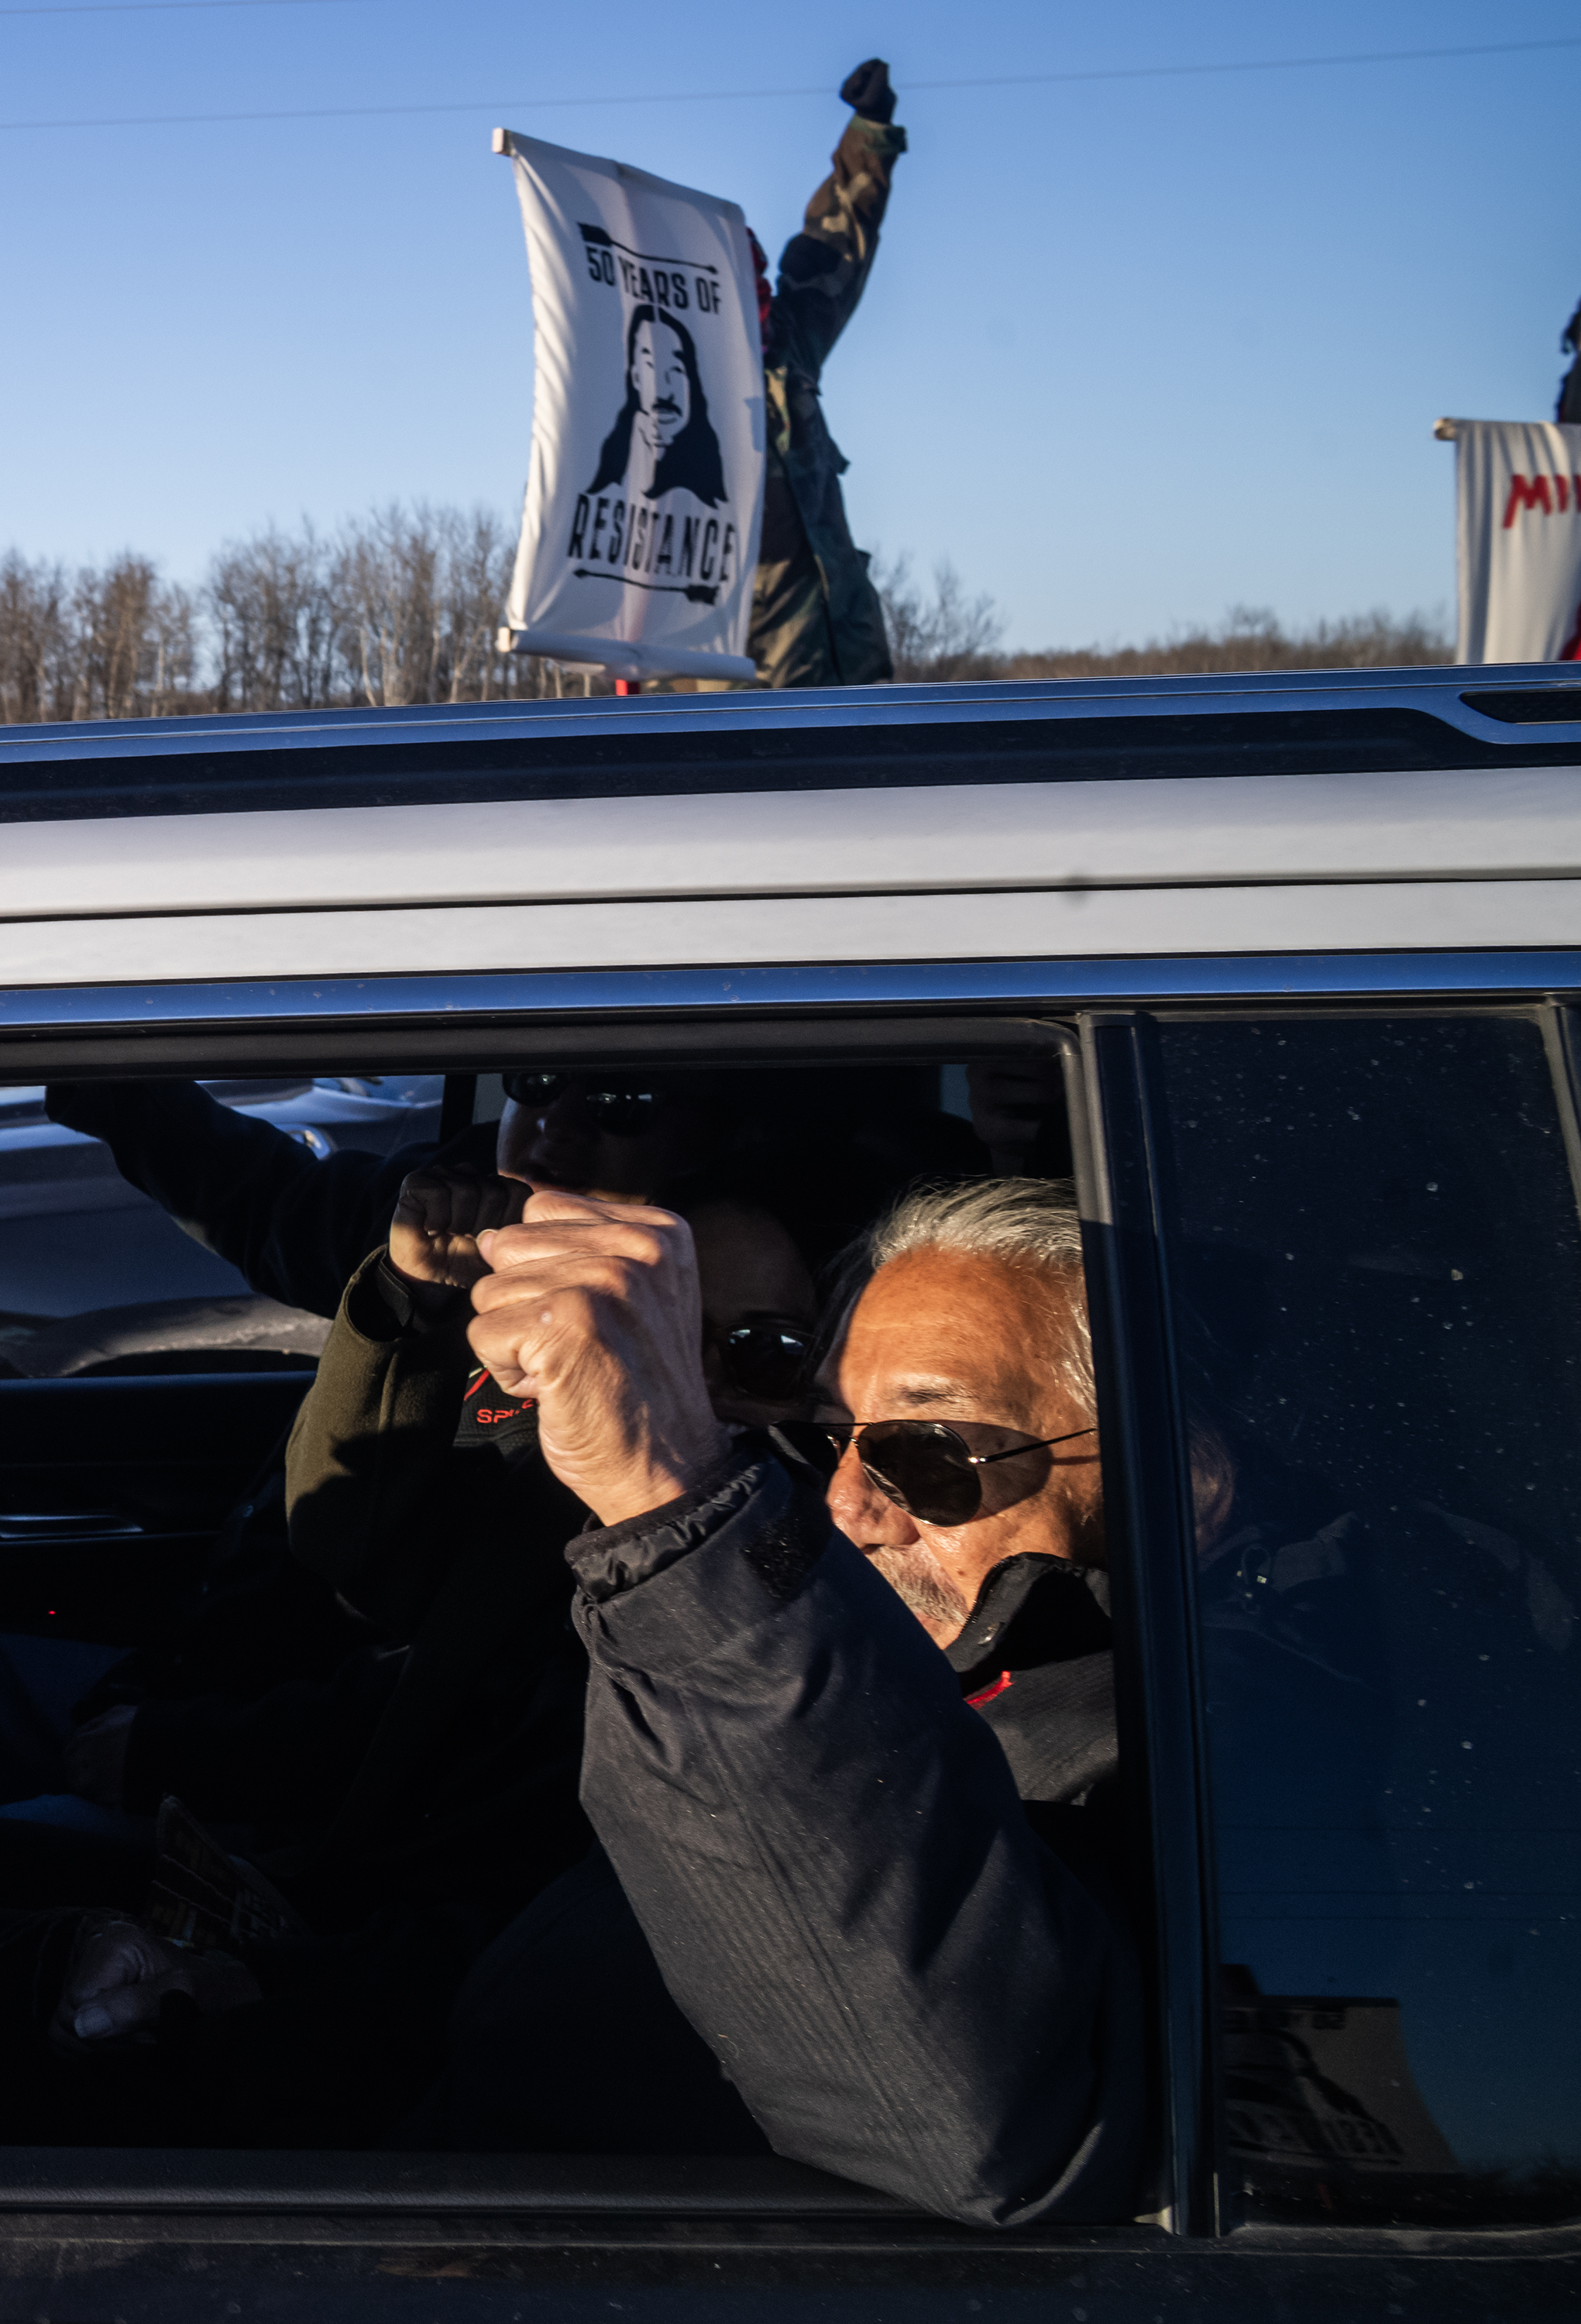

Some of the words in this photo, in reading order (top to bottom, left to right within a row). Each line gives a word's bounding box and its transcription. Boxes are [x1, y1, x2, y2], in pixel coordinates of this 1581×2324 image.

[586, 245, 616, 287] 50
[618, 256, 689, 310] YEARS
[696, 276, 720, 314] OF
[568, 493, 735, 582] RESISTANCE
